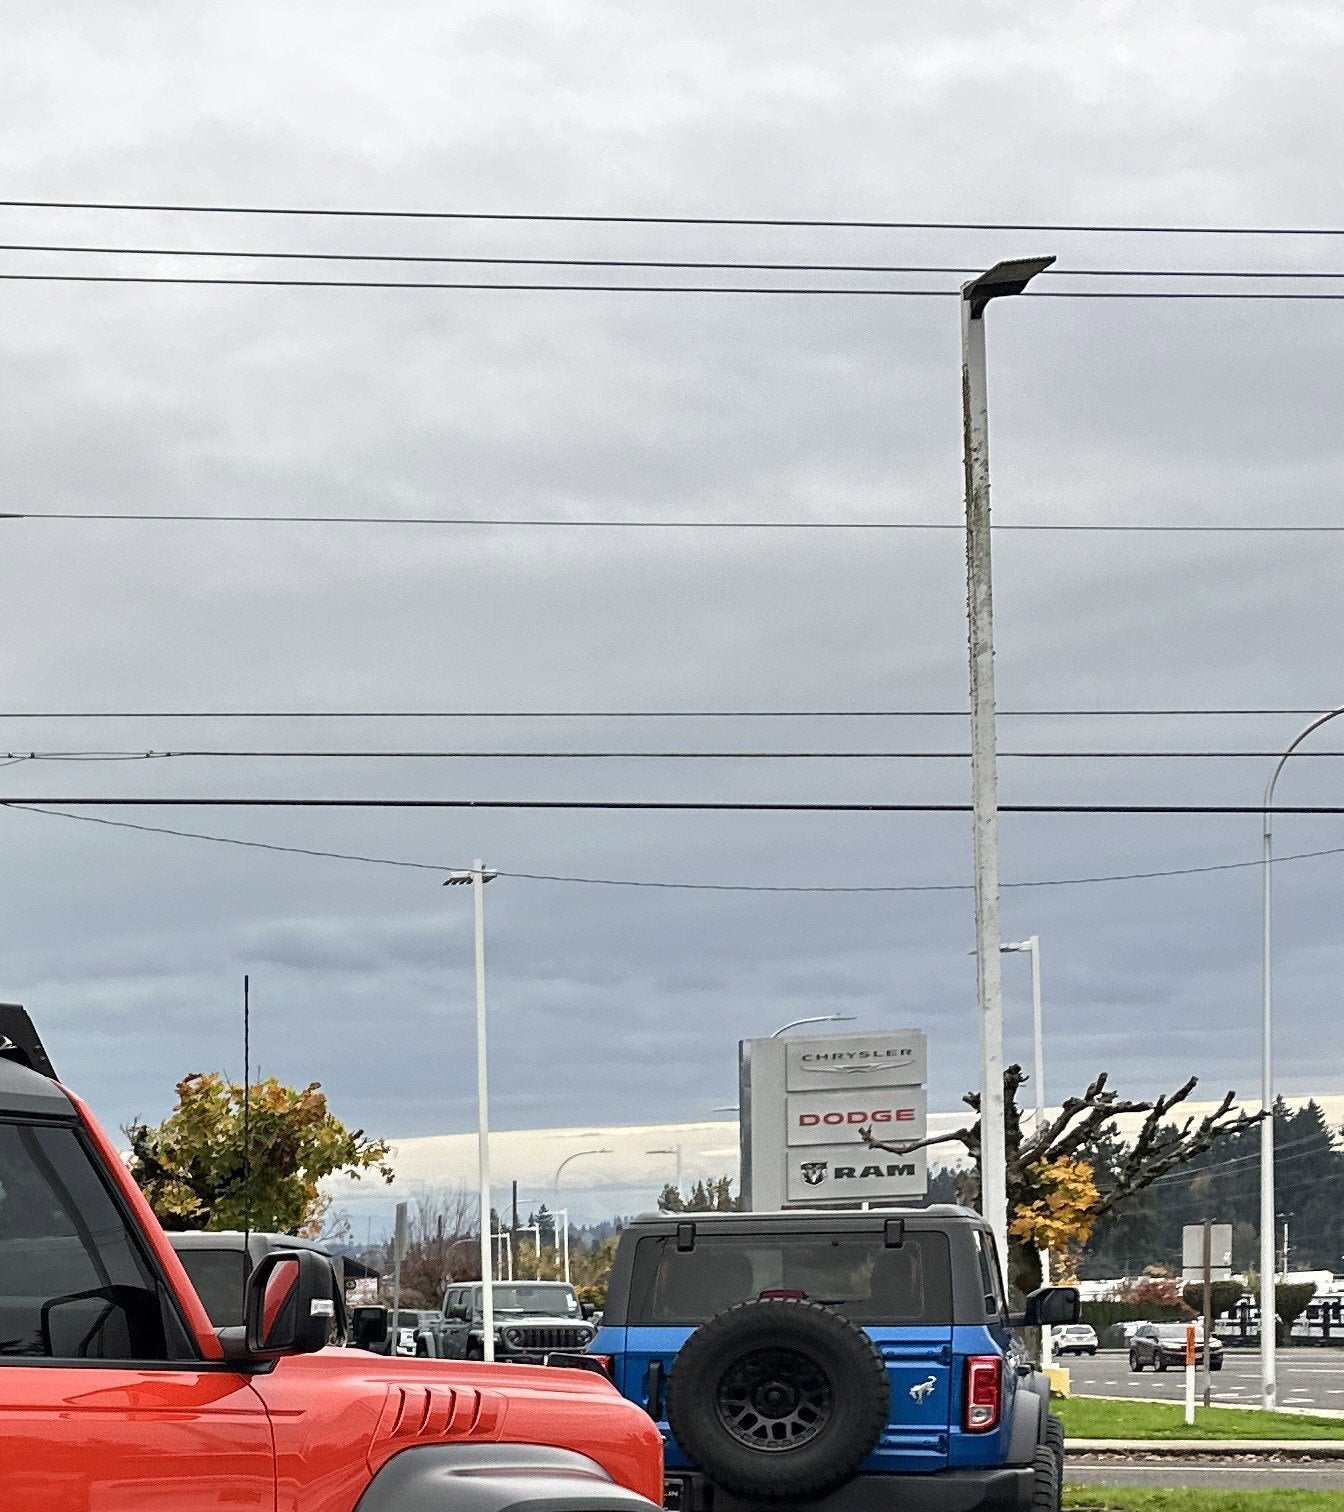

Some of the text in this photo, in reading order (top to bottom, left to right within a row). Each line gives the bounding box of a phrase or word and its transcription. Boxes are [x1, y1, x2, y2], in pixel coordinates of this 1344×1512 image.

[801, 1048, 914, 1063] CHRYSLER
[798, 1108, 916, 1127] DODGE
[834, 1163, 916, 1180] RAM
